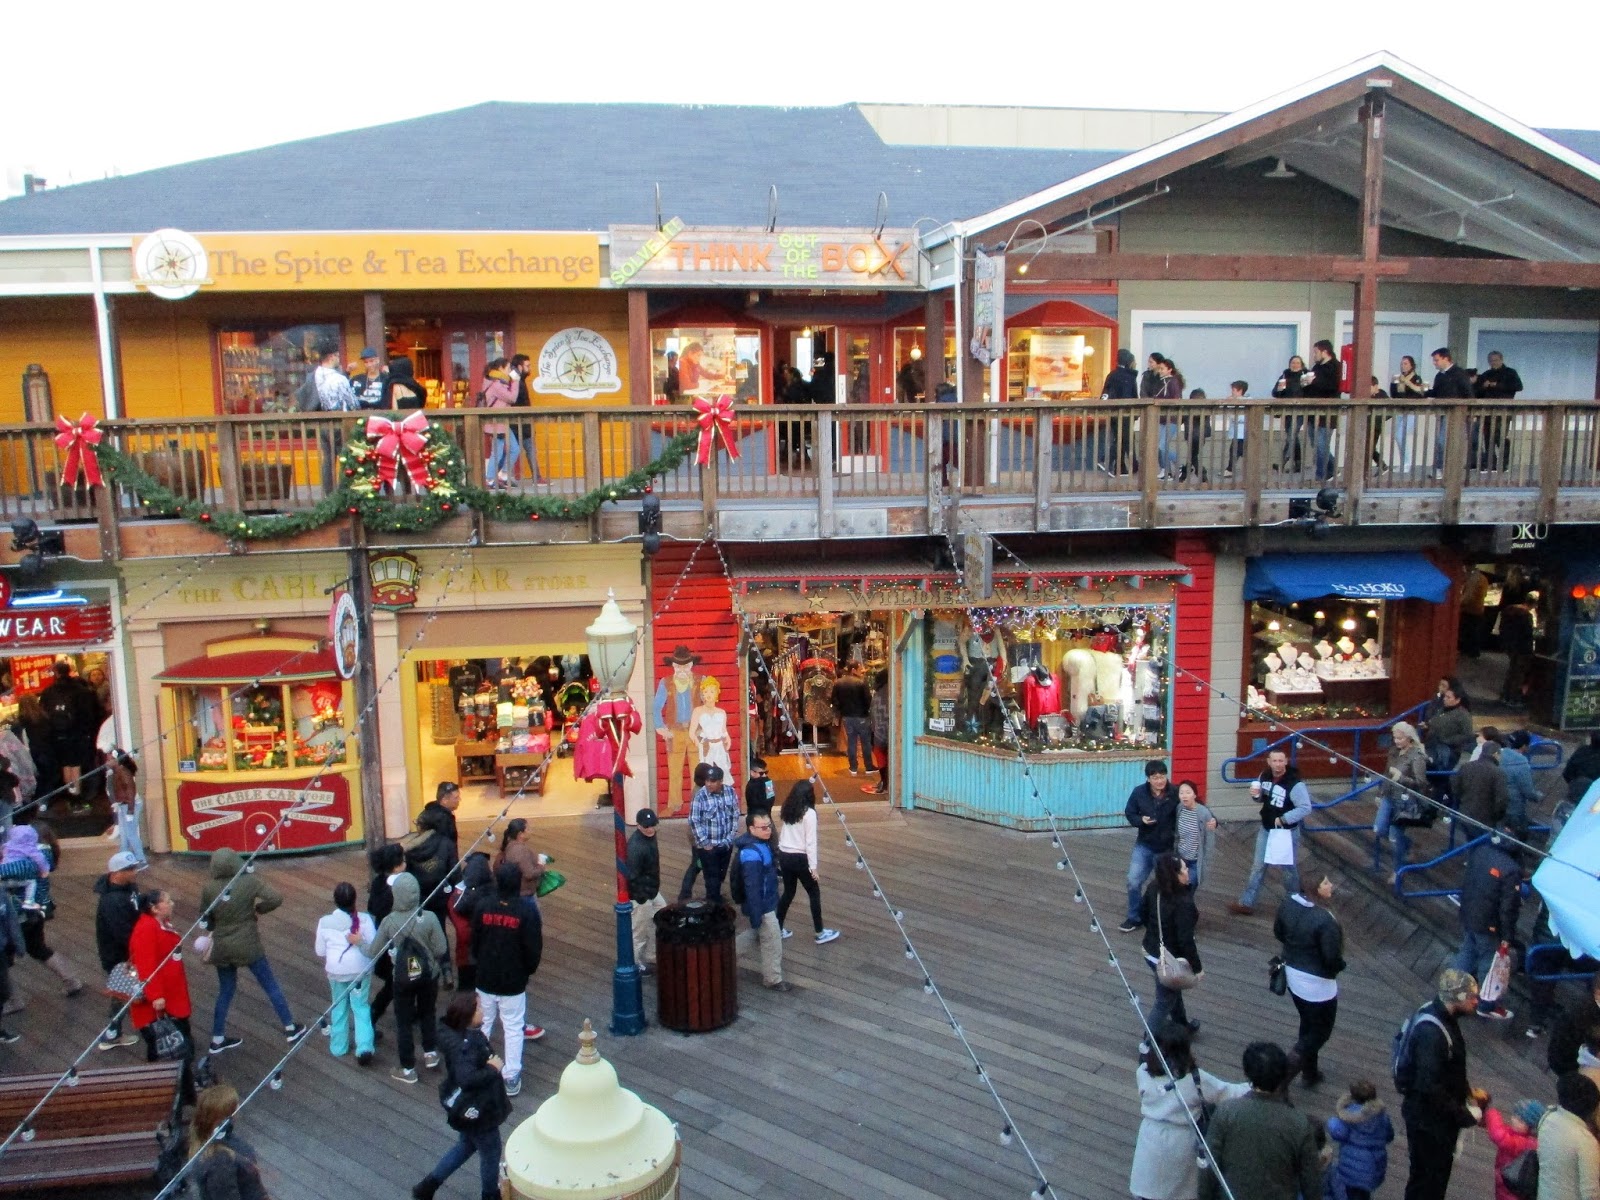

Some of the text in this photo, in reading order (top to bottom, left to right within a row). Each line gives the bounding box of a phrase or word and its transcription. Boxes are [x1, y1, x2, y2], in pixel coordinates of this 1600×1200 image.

[779, 234, 816, 248] OUT
[611, 237, 658, 285] SOLVE
[669, 241, 773, 272] THINK
[786, 249, 811, 263] OF
[822, 235, 911, 280] BOX
[209, 248, 594, 283] The Spice & Tea Exchange
[782, 264, 817, 279] THE
[438, 567, 589, 593] CAR STORE
[1358, 582, 1406, 593] HOKU
[178, 588, 221, 602] THE
[994, 587, 1078, 604] WEST
[194, 798, 214, 809] THE
[217, 789, 262, 806] CABLE
[266, 789, 296, 801] CAR
